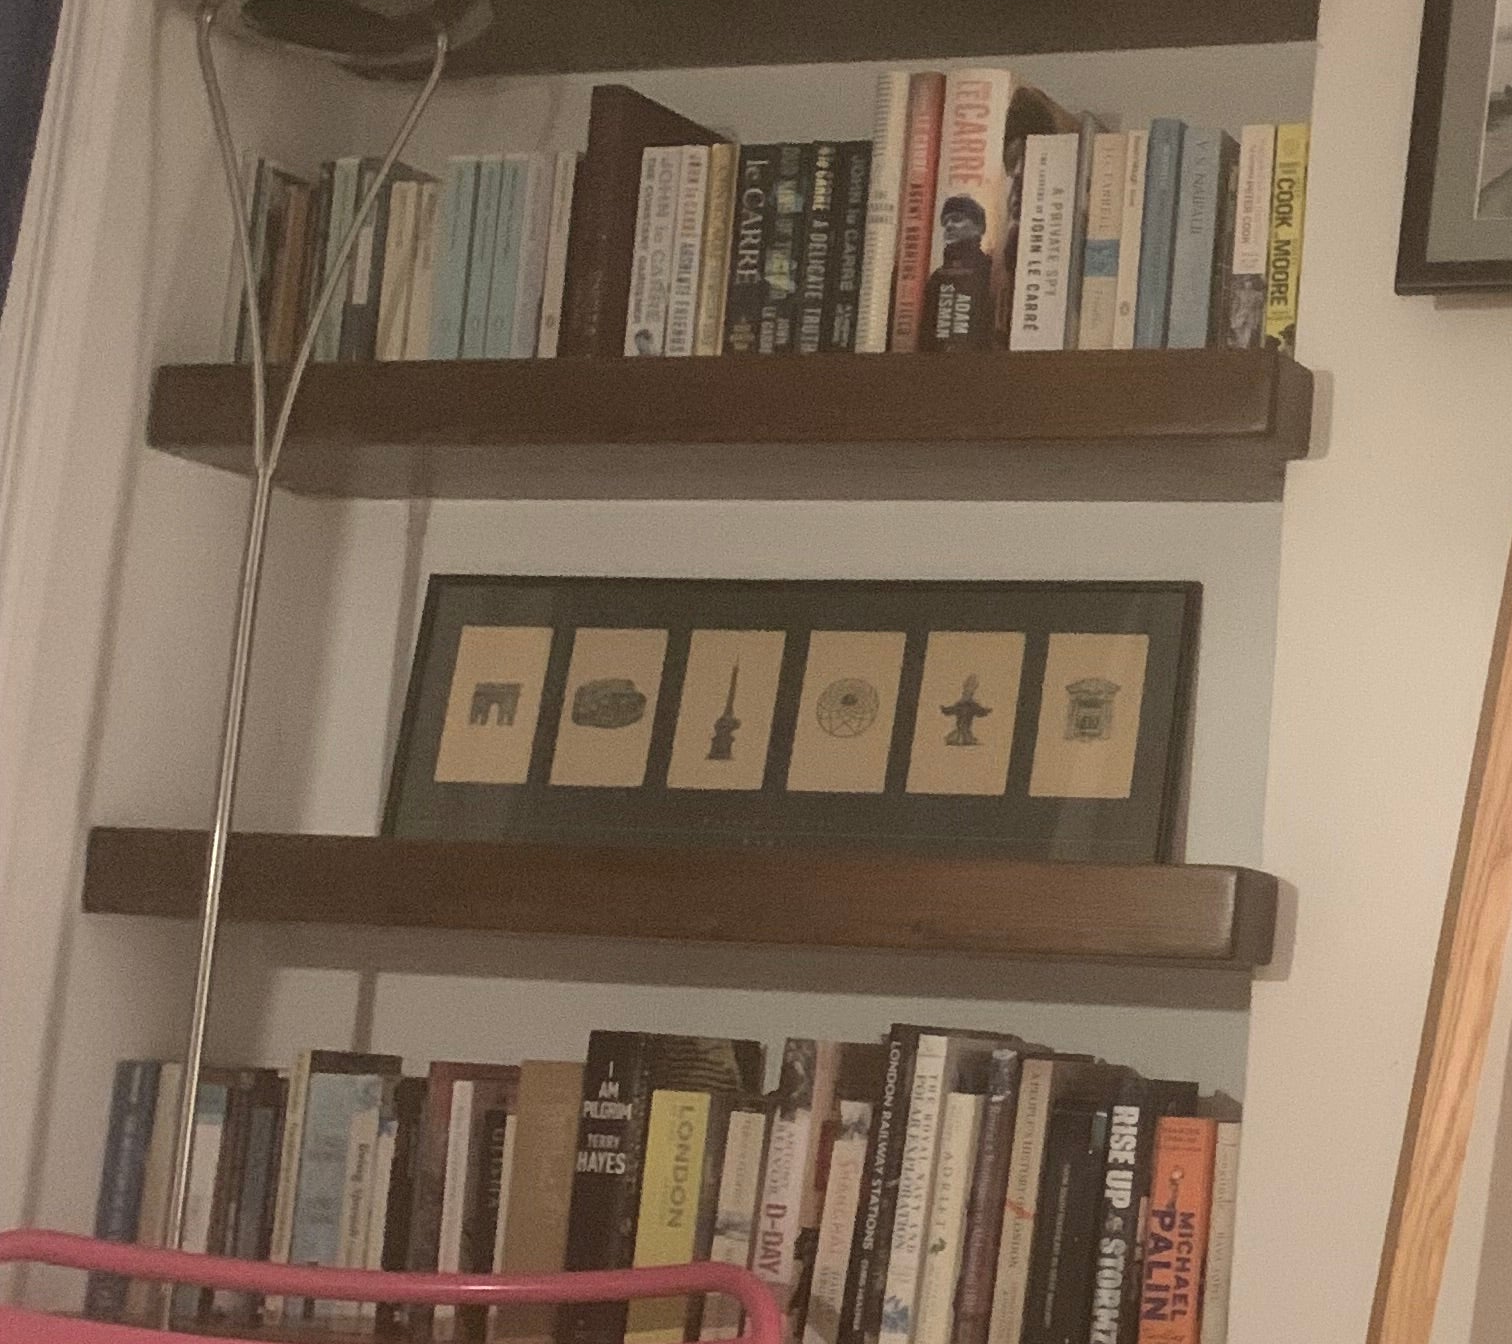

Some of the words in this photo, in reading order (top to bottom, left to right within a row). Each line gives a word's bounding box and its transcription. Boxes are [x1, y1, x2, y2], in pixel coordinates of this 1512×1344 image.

[745, 159, 768, 181] le
[849, 155, 864, 203] JOHN
[1052, 188, 1064, 196] A
[907, 183, 924, 221] AGENT
[1274, 178, 1294, 228] COOK
[1029, 218, 1045, 254] JOHN
[1047, 203, 1063, 262] PRIVATE
[1240, 215, 1251, 245] COOK
[805, 233, 827, 299] DELICATE
[1027, 260, 1041, 277] LE
[1045, 270, 1060, 297] SPY
[1270, 239, 1292, 307] MOORE
[671, 300, 690, 353] FRIENDS
[801, 308, 820, 353] TRUTH
[936, 283, 955, 338] SISMAN
[953, 294, 971, 334] ADAM
[1023, 284, 1039, 332] CARRÉ
[598, 1080, 620, 1099] AM
[608, 1060, 614, 1079] I
[883, 1040, 901, 1106] LONDON
[927, 1073, 939, 1105] THE
[583, 1100, 633, 1121] PILGRIM
[909, 1074, 927, 1129] POLAR
[872, 1111, 891, 1174] RAILWAY
[918, 1112, 934, 1161] ROYAL
[1107, 1105, 1140, 1166] RISE
[576, 1151, 626, 1175] HAYES
[666, 1104, 695, 1229] LONDON
[1016, 1140, 1033, 1195] HISTORY
[894, 1132, 918, 1250] EXPLORATION
[911, 1173, 926, 1214] NAVY
[935, 1151, 954, 1228] ADRIFT
[1104, 1169, 1134, 1209] UP
[862, 1178, 882, 1251] STATIONS
[905, 1223, 920, 1254] AND
[758, 1203, 787, 1275] D-DAY
[1142, 1209, 1176, 1322] PALIN
[1170, 1212, 1196, 1323] MICHAEL
